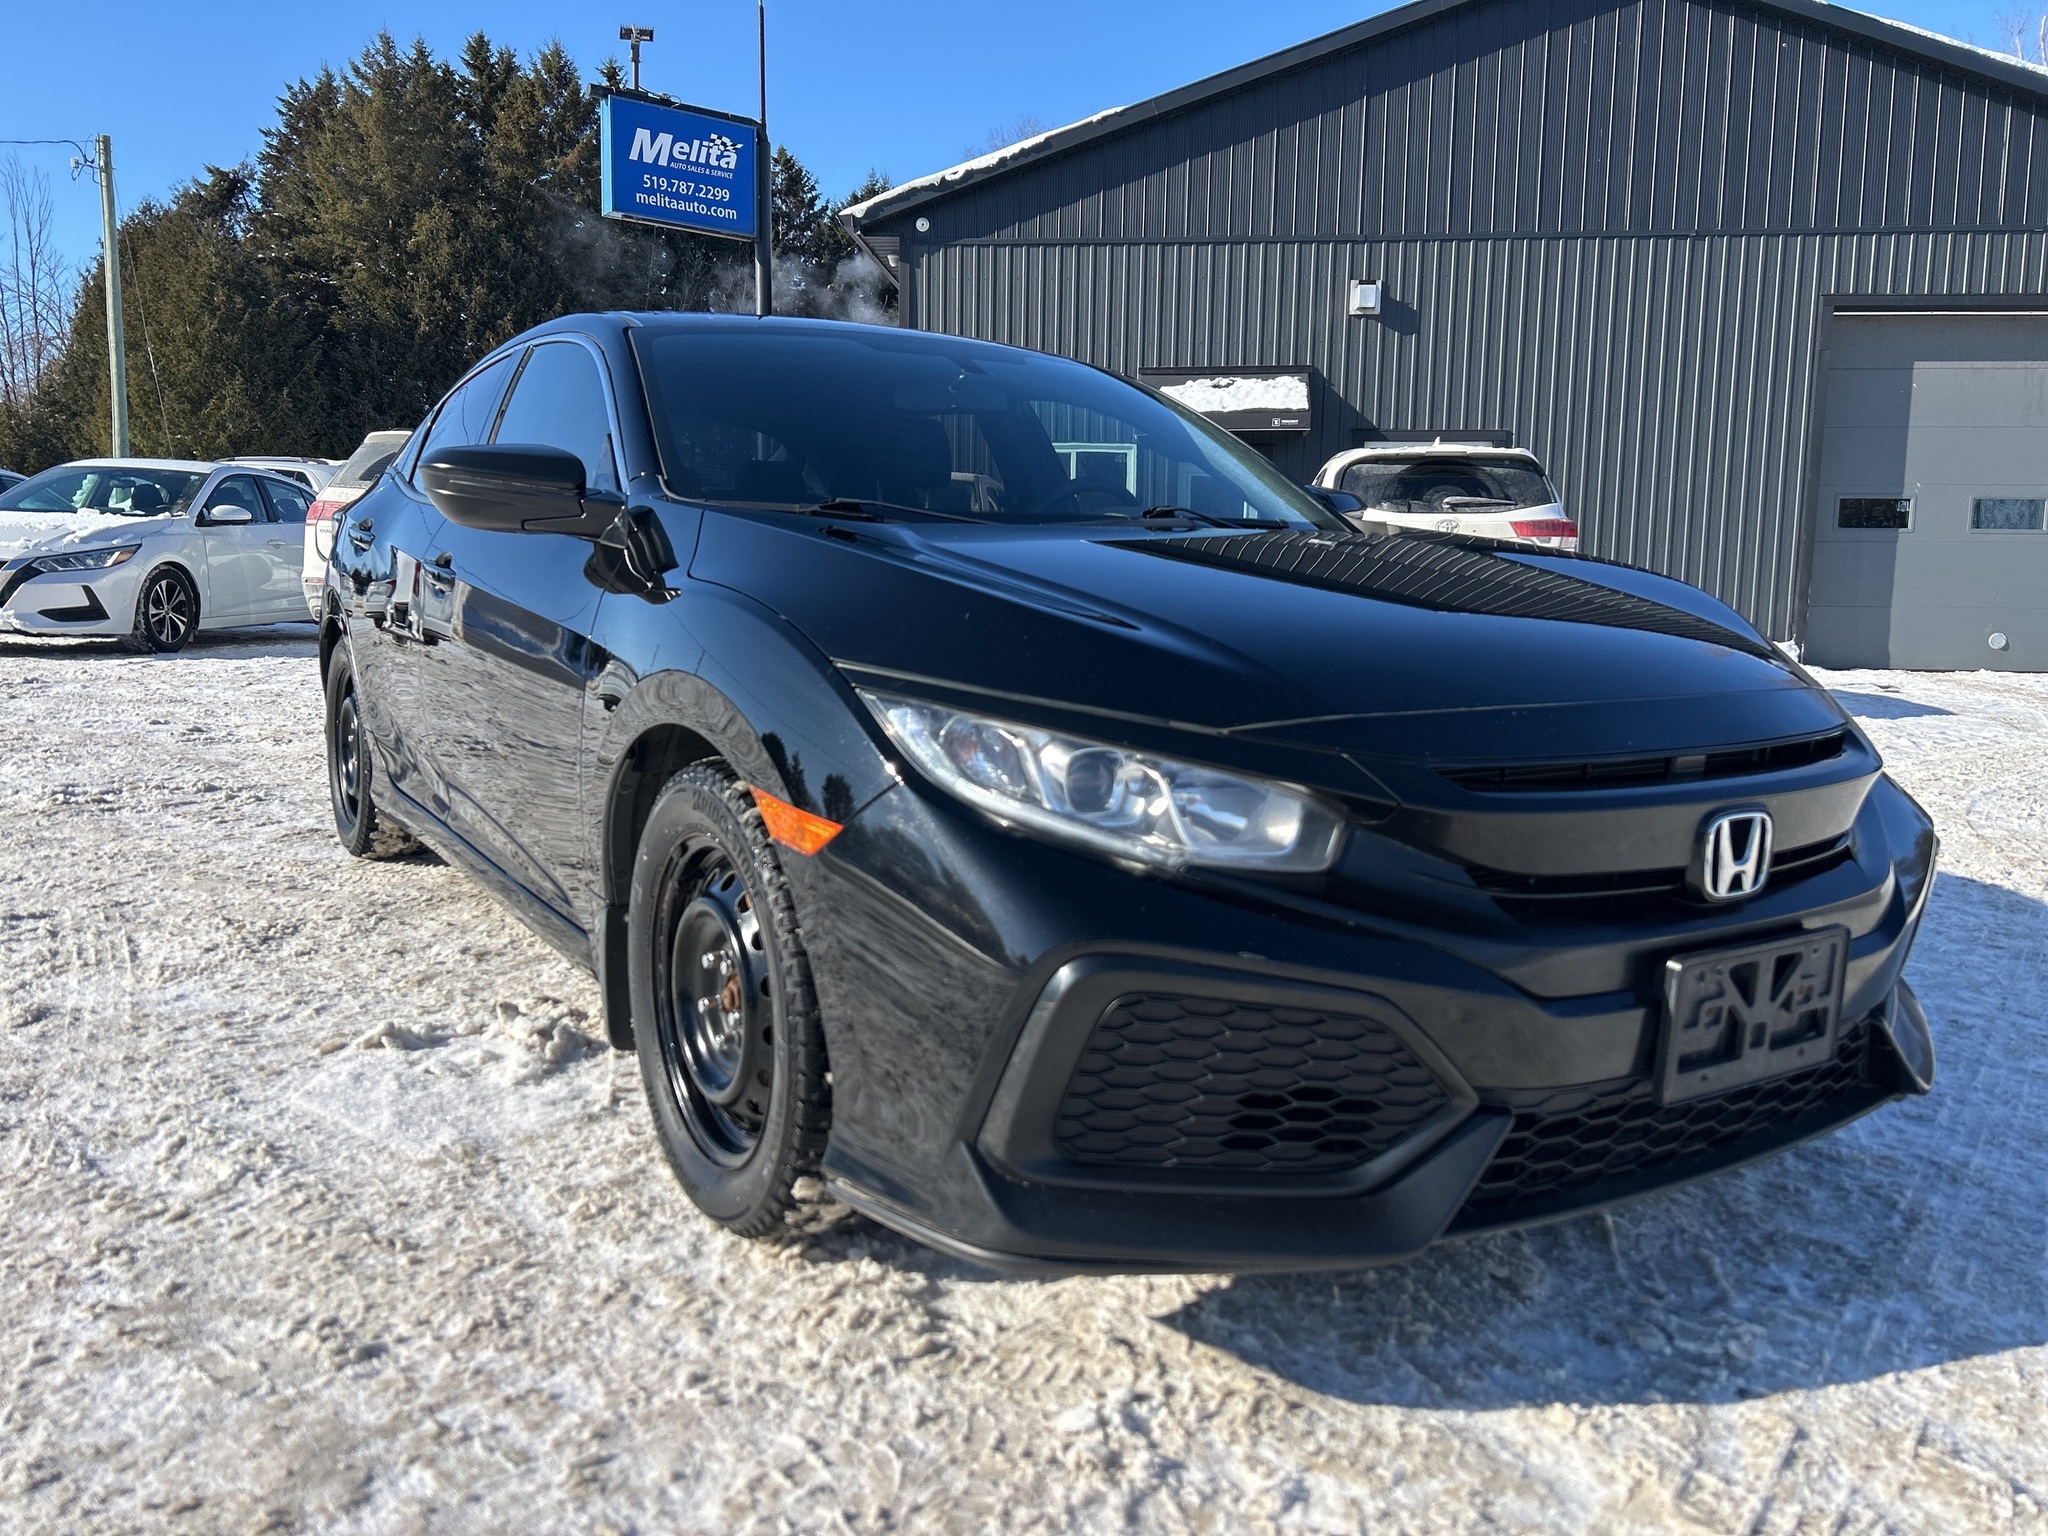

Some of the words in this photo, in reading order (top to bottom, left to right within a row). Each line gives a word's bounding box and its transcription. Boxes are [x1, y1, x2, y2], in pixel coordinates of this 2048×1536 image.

[630, 128, 738, 169] Melita
[670, 162, 686, 170] AUTO
[687, 165, 704, 173] SALES
[711, 170, 733, 179] SERVICE
[643, 175, 730, 201] 519.787.2299
[636, 192, 737, 220] melitaauto.com
